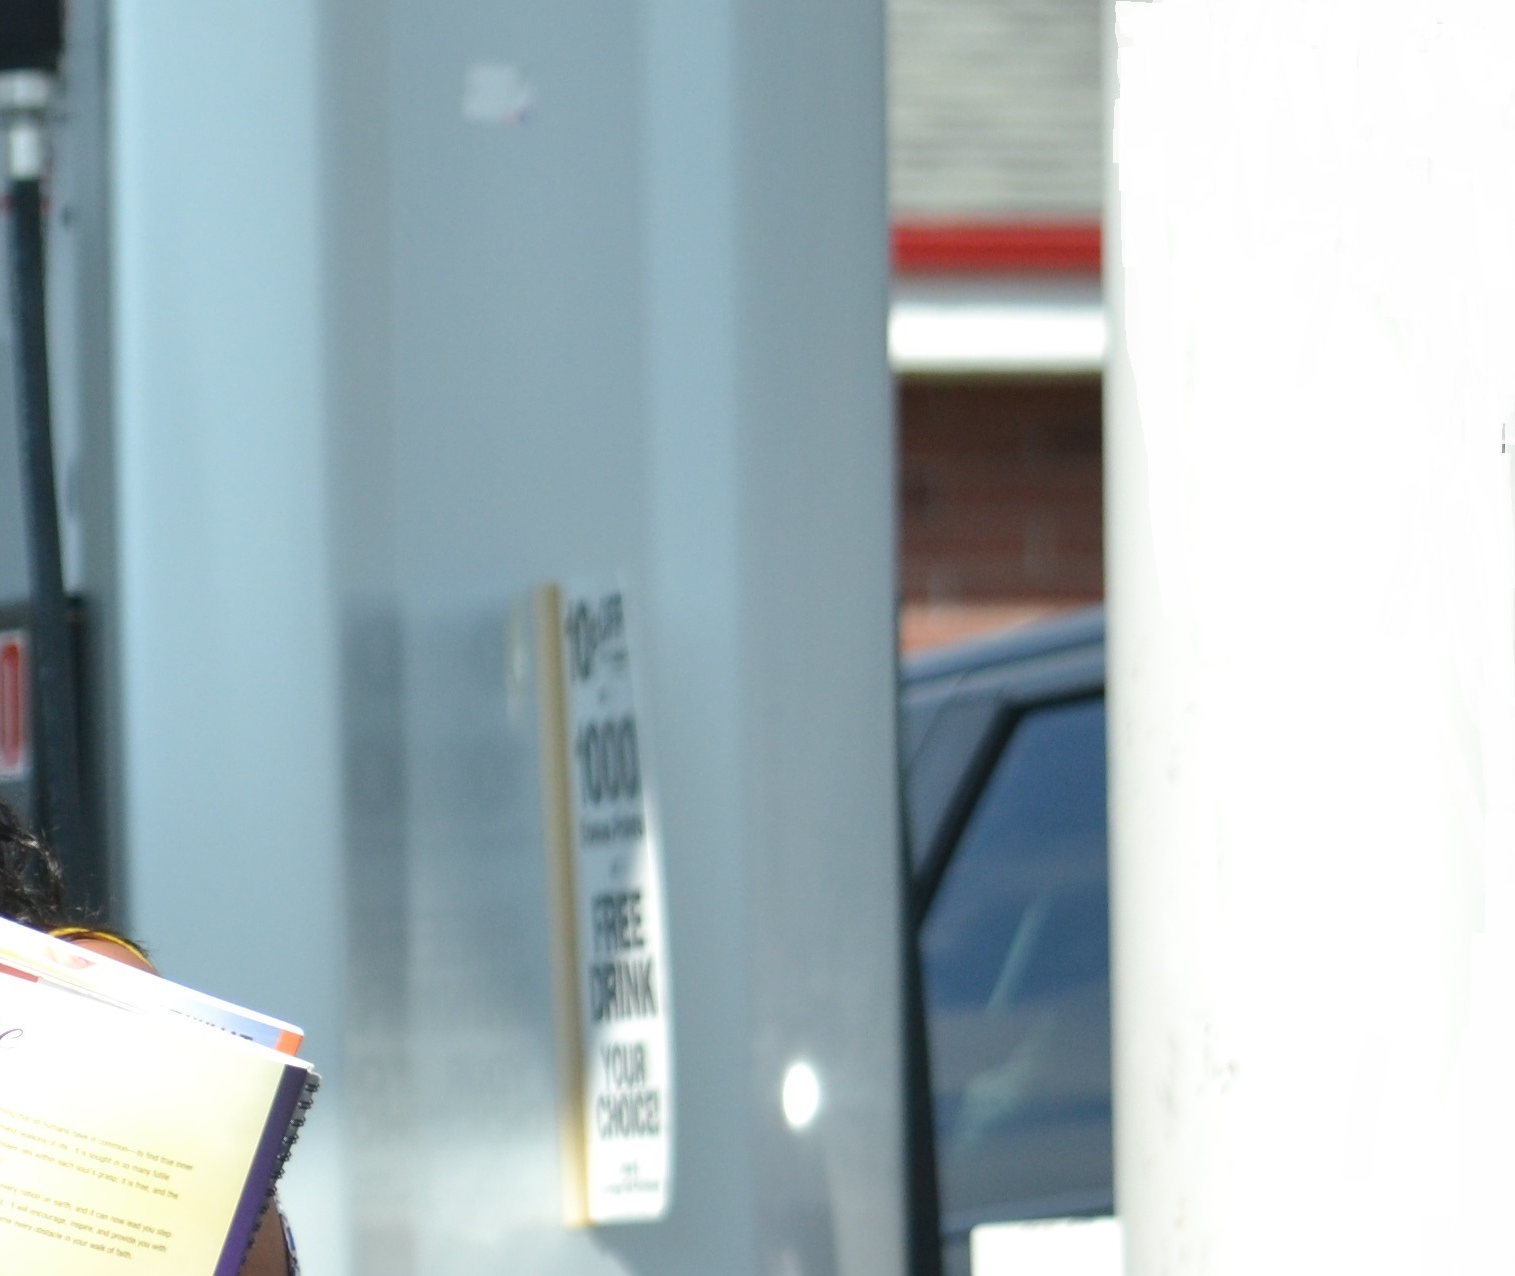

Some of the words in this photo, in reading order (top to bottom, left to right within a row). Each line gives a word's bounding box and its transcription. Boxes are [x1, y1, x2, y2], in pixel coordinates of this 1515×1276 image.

[592, 890, 644, 950] FREE
[590, 956, 658, 1023] DRINK
[600, 1041, 646, 1090] YOUR
